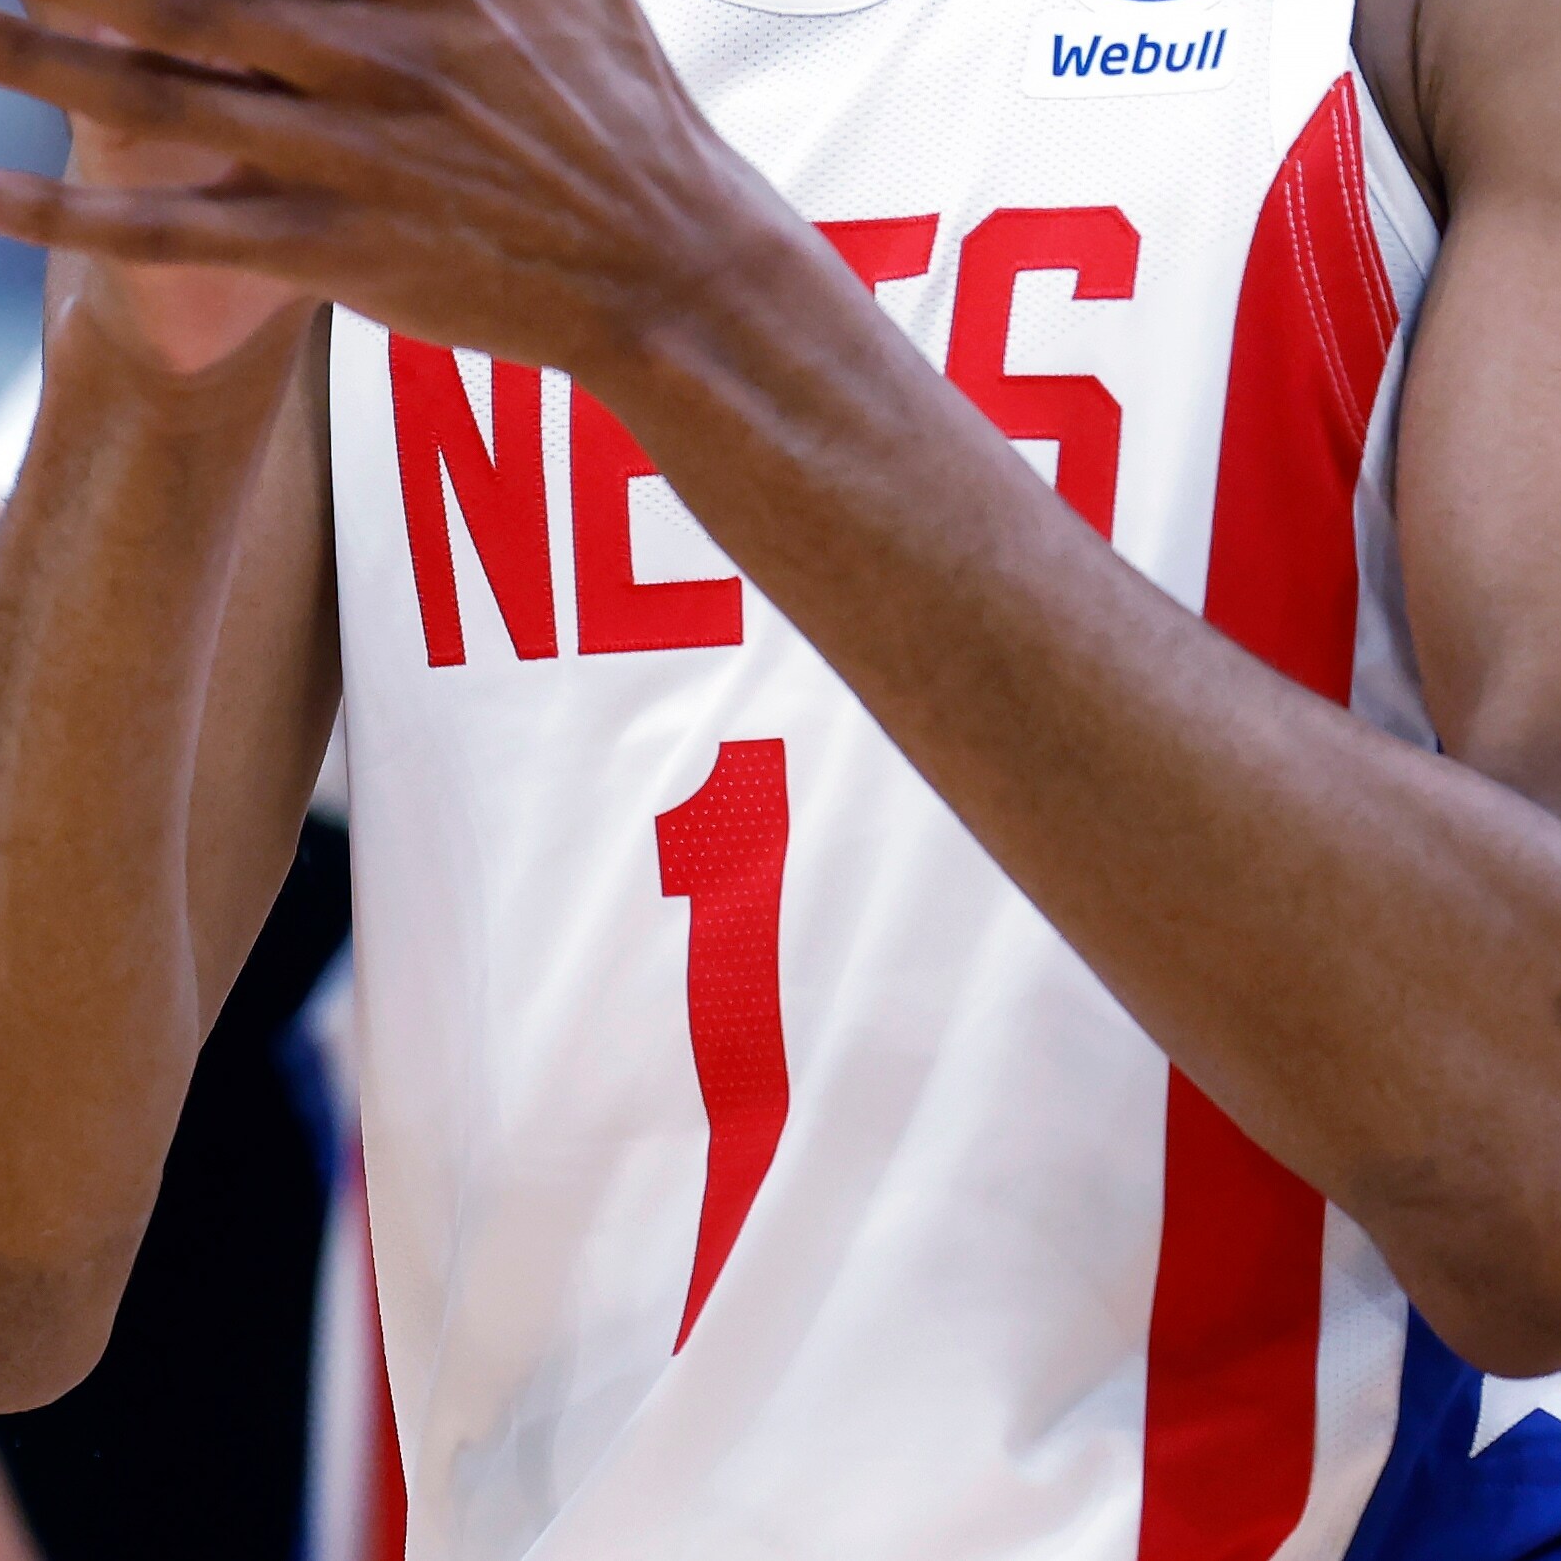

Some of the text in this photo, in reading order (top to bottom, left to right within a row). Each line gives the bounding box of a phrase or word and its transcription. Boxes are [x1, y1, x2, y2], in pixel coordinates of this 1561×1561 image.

[1052, 28, 1227, 77] Webull
[388, 205, 1140, 667] NES
[655, 737, 789, 1356] 1
